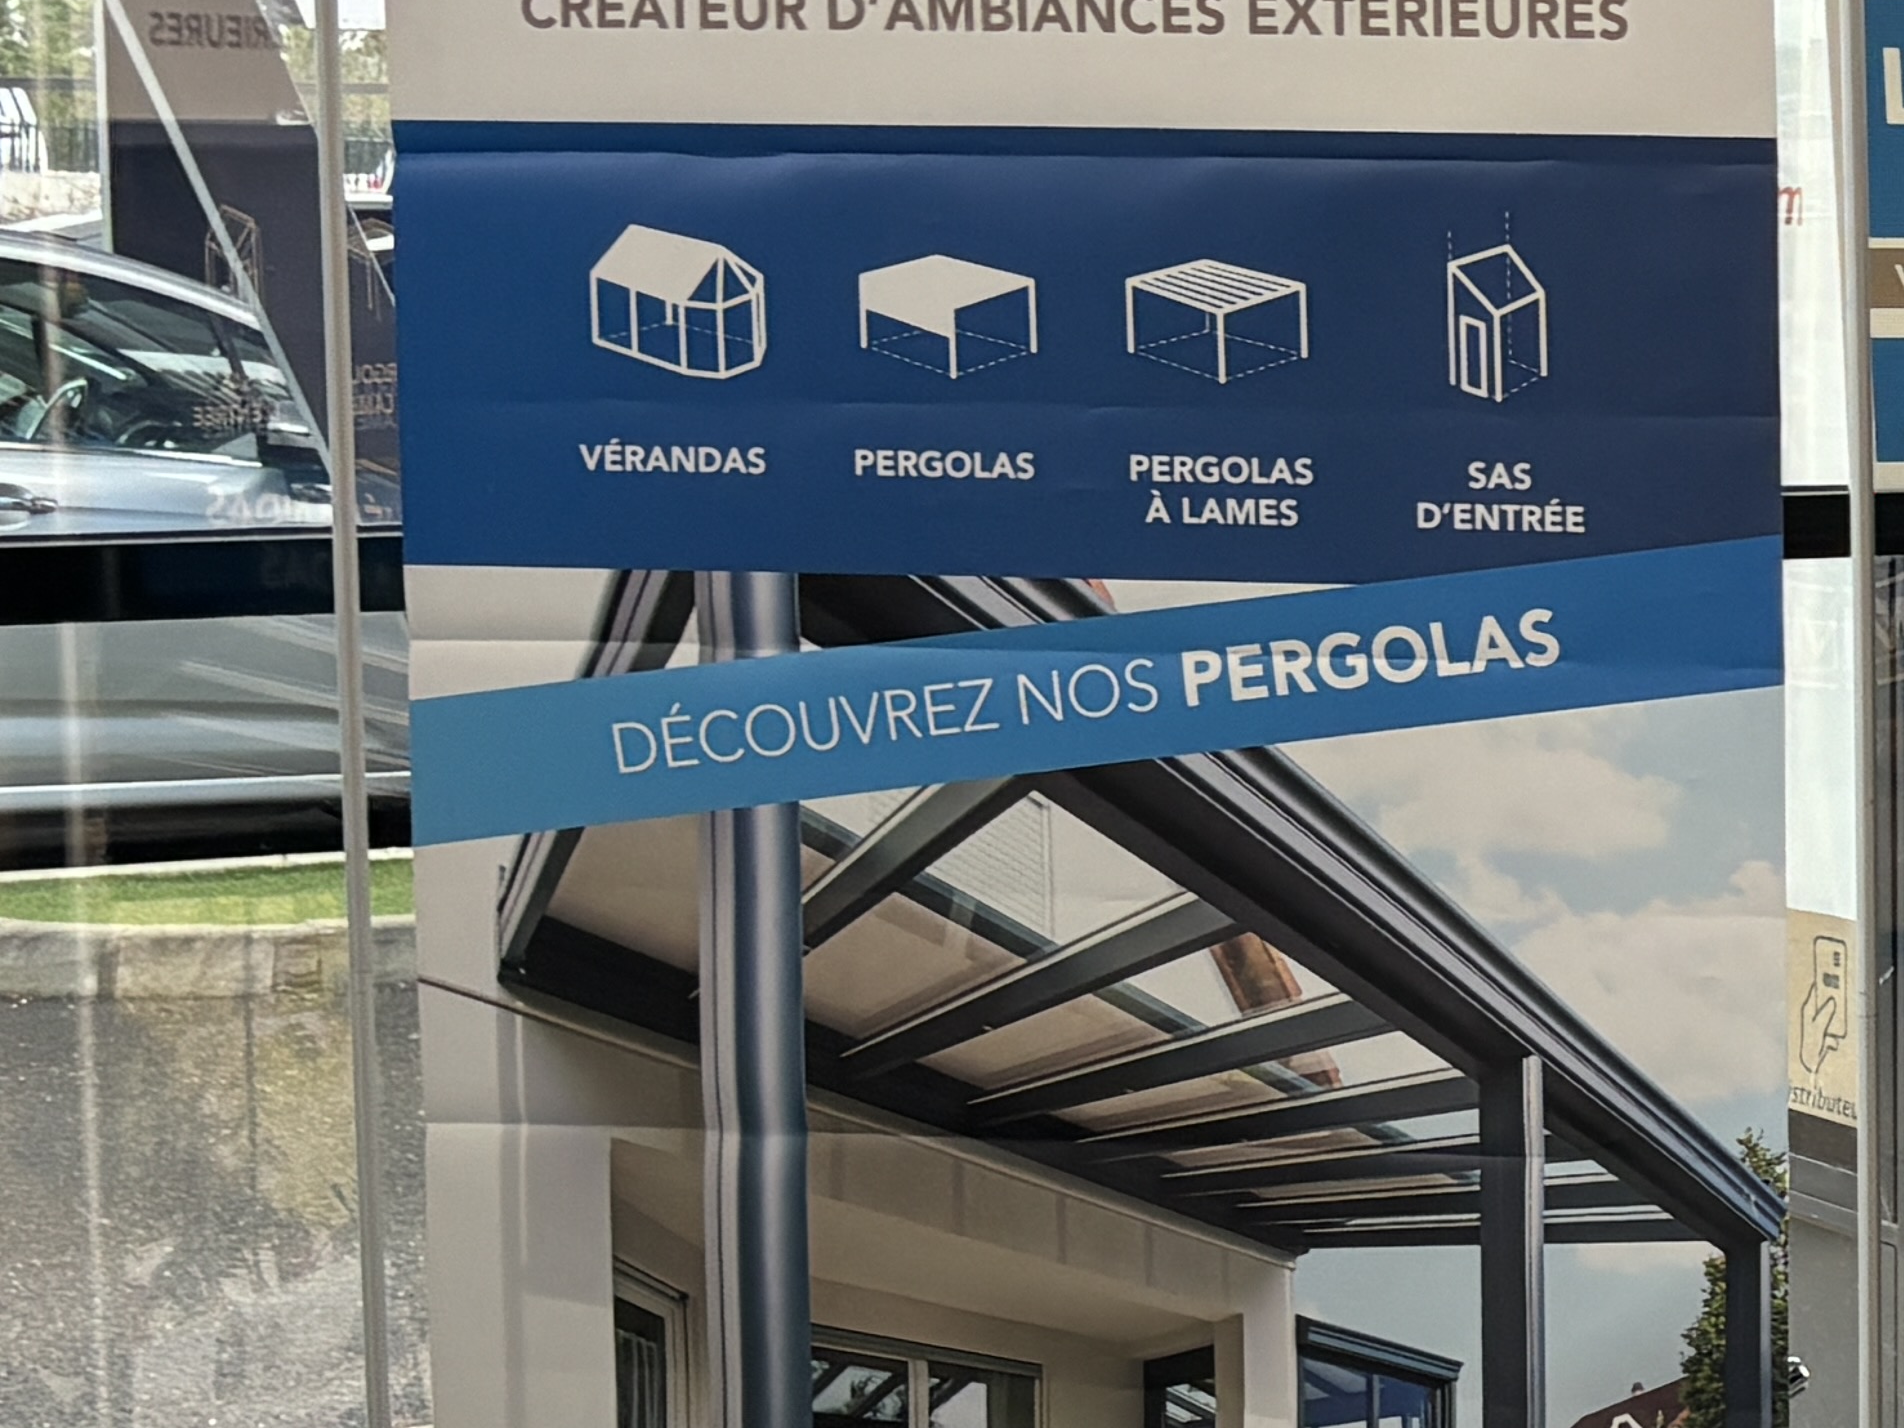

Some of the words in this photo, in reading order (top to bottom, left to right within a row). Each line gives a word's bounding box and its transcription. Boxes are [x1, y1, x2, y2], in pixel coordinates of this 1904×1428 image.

[578, 438, 767, 476] VÉRANDAS
[853, 448, 1036, 480] PERGOLAS
[1128, 454, 1315, 488] PERGOLAS
[1467, 461, 1532, 492] SAS
[1145, 484, 1172, 527] À
[1180, 495, 1299, 528] LAMES
[1415, 493, 1586, 535] D'ENTRÉE
[611, 679, 998, 777] DÉCOUVREZ
[1017, 659, 1160, 726] NOS
[1180, 608, 1560, 708] PERGOLAS
